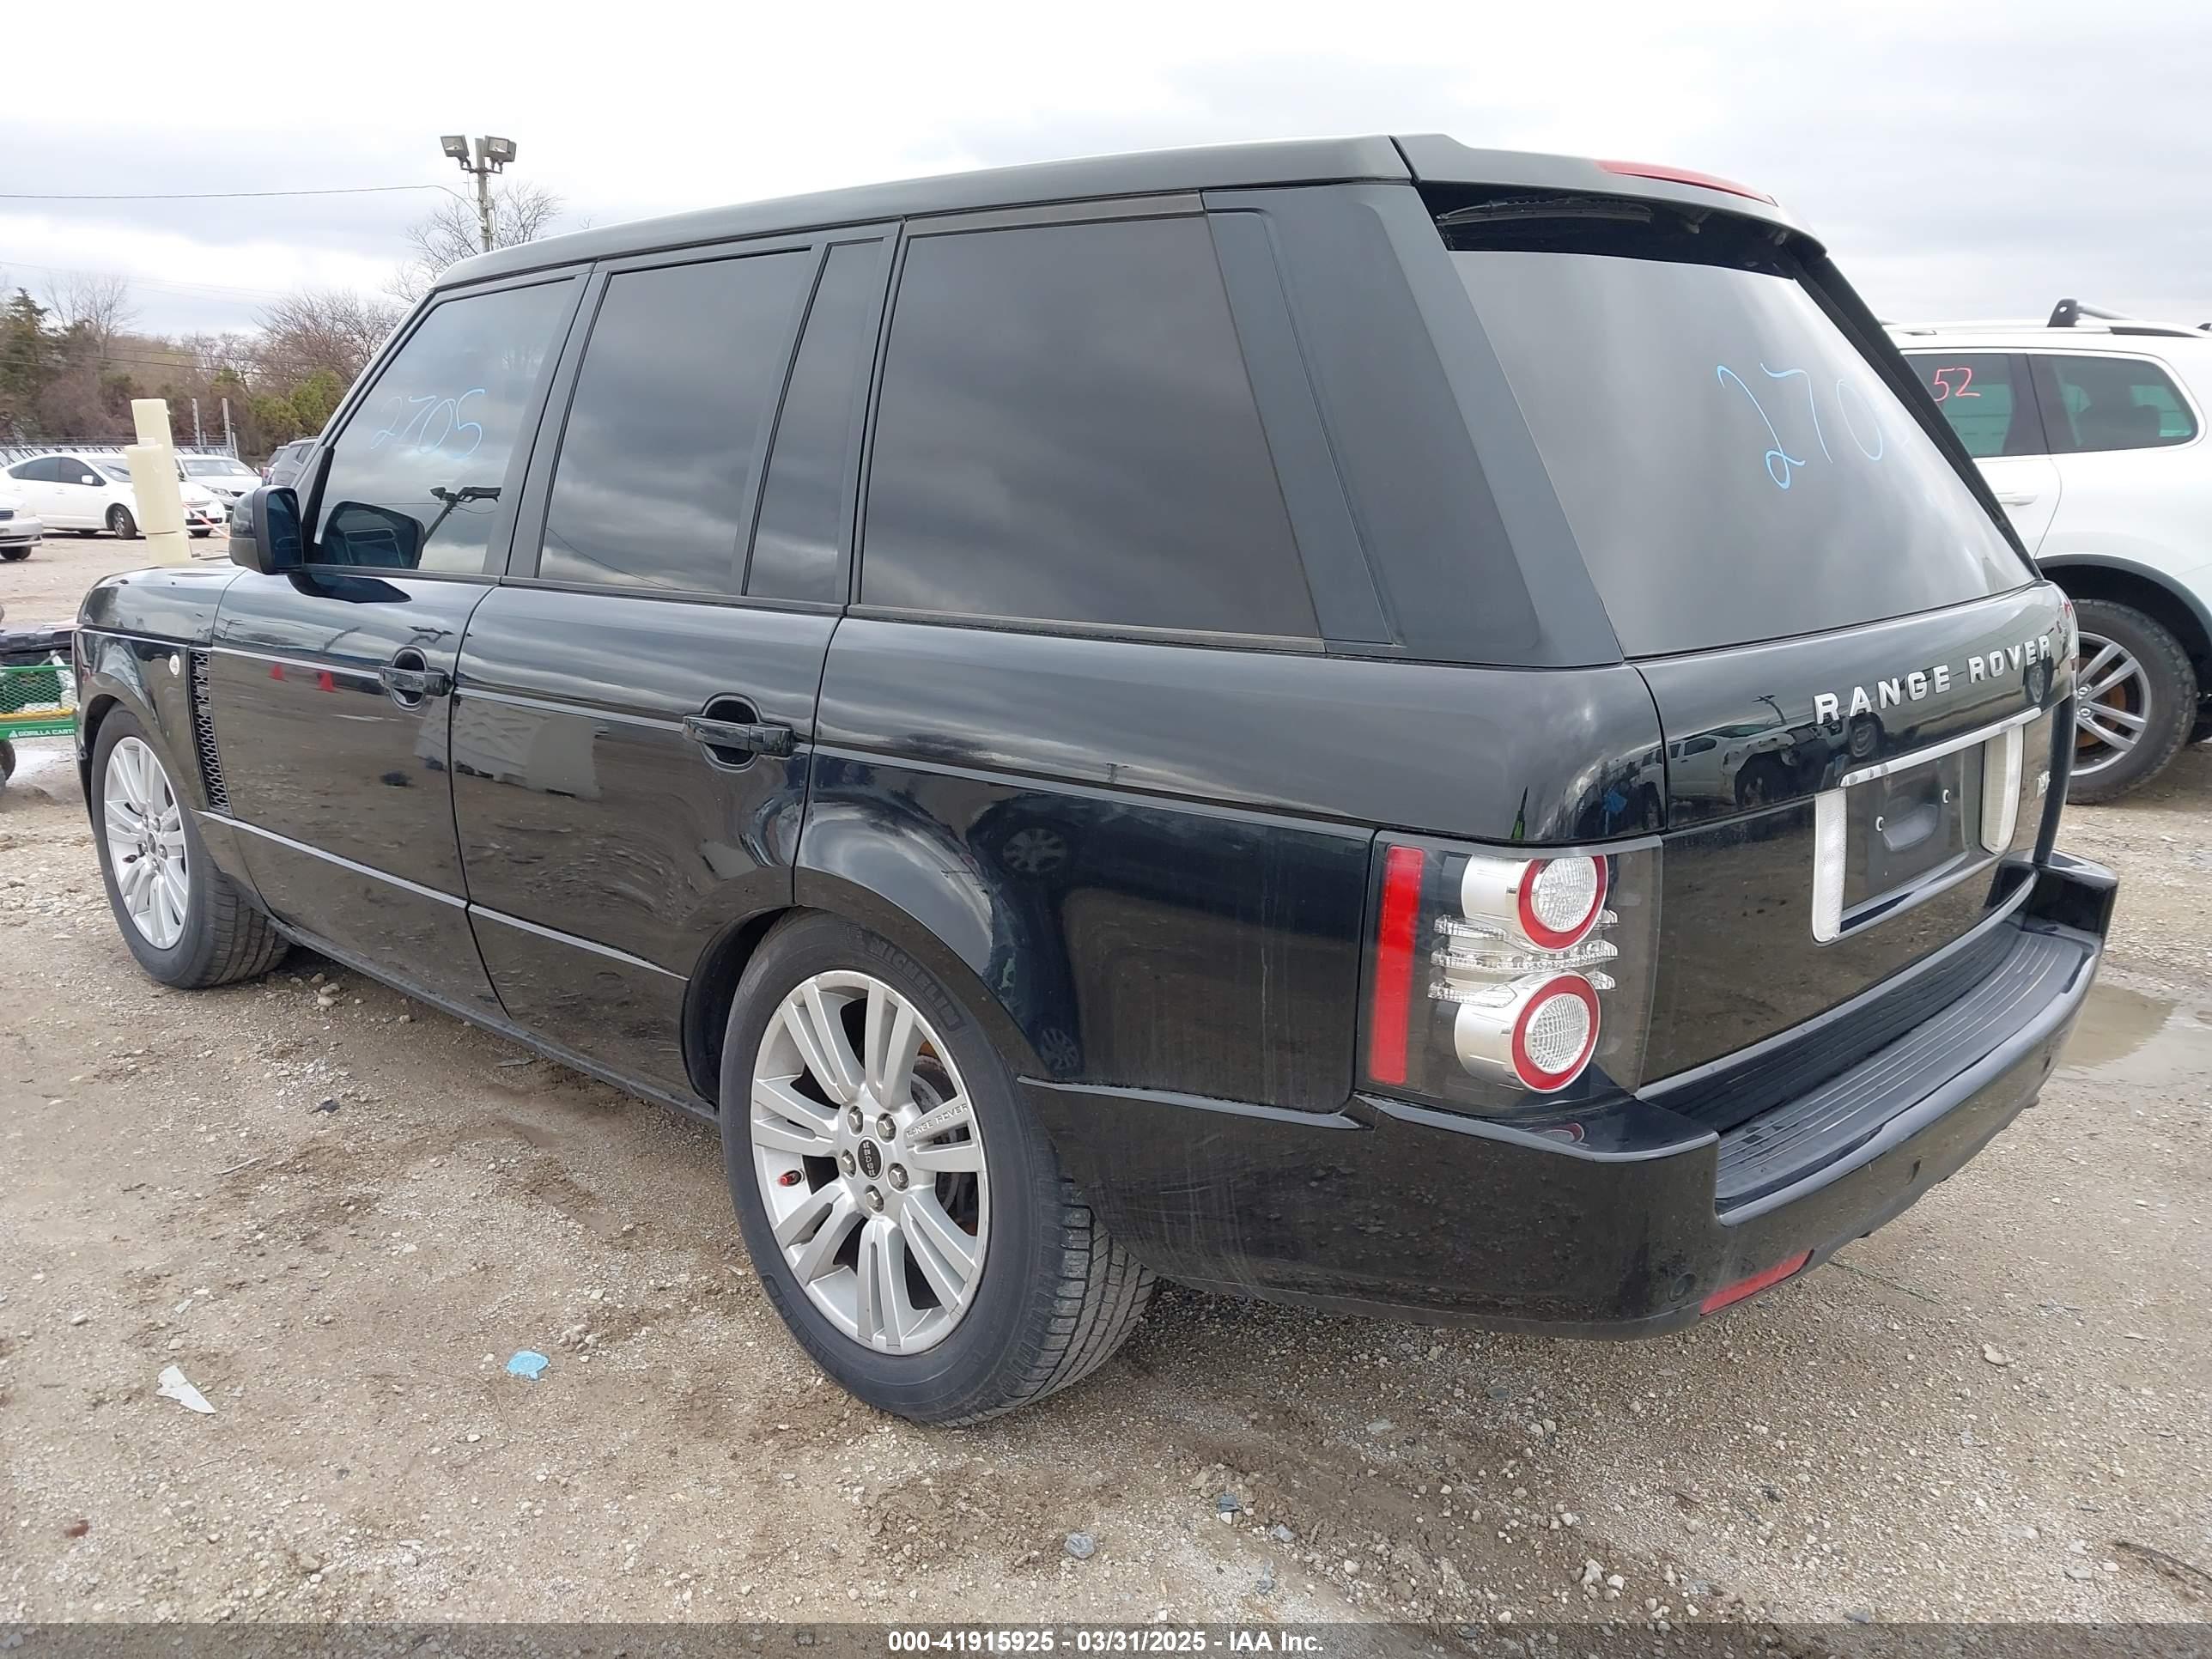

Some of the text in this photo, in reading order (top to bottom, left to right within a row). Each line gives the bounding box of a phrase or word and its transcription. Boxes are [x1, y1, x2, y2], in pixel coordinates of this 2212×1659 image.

[370, 387, 486, 460] 2705
[1934, 367, 1981, 402] 52
[1813, 635, 2051, 724] RANGE ROVER
[867, 935, 960, 1026] MICHELIN
